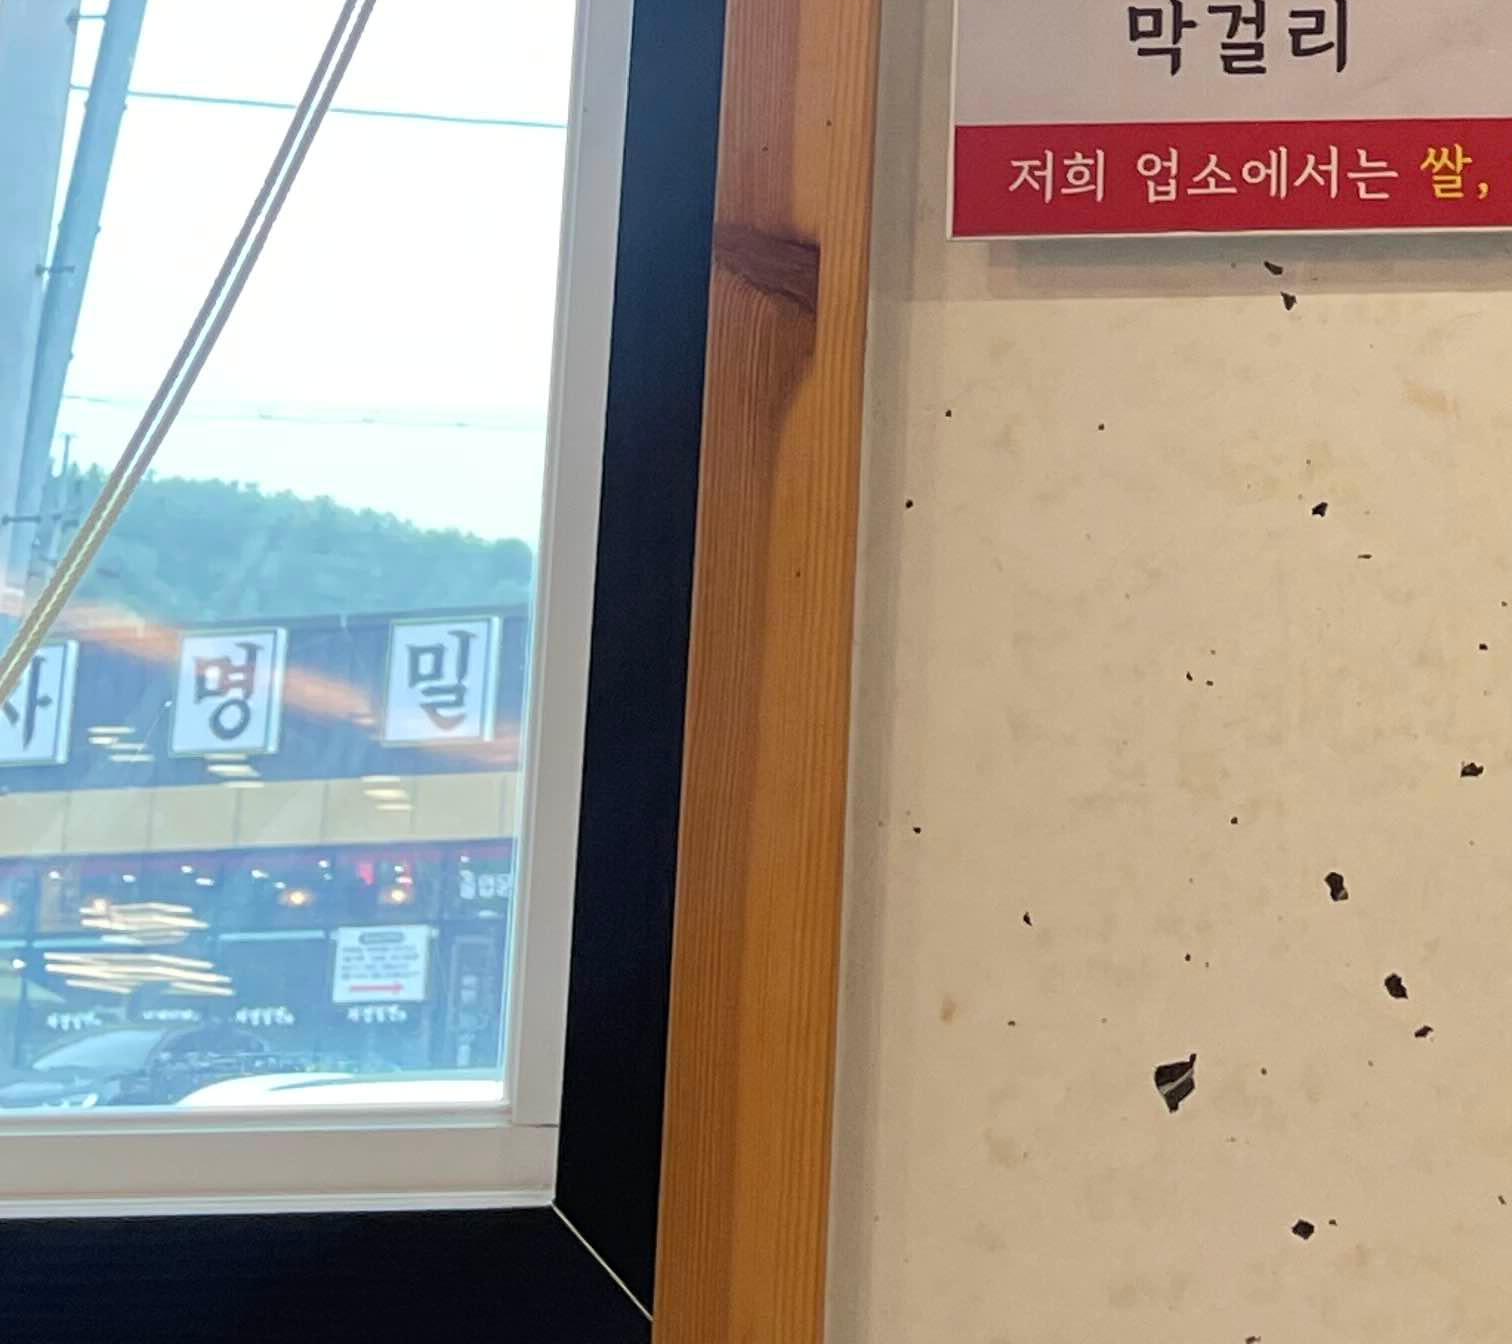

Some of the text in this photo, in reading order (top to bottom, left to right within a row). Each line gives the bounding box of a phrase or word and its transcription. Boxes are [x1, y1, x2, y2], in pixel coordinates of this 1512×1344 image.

[1009, 150, 1104, 203] 저희
[1137, 145, 1398, 202] 업소에서는
[1421, 144, 1488, 198] 쌀,
[406, 630, 478, 729] 밀
